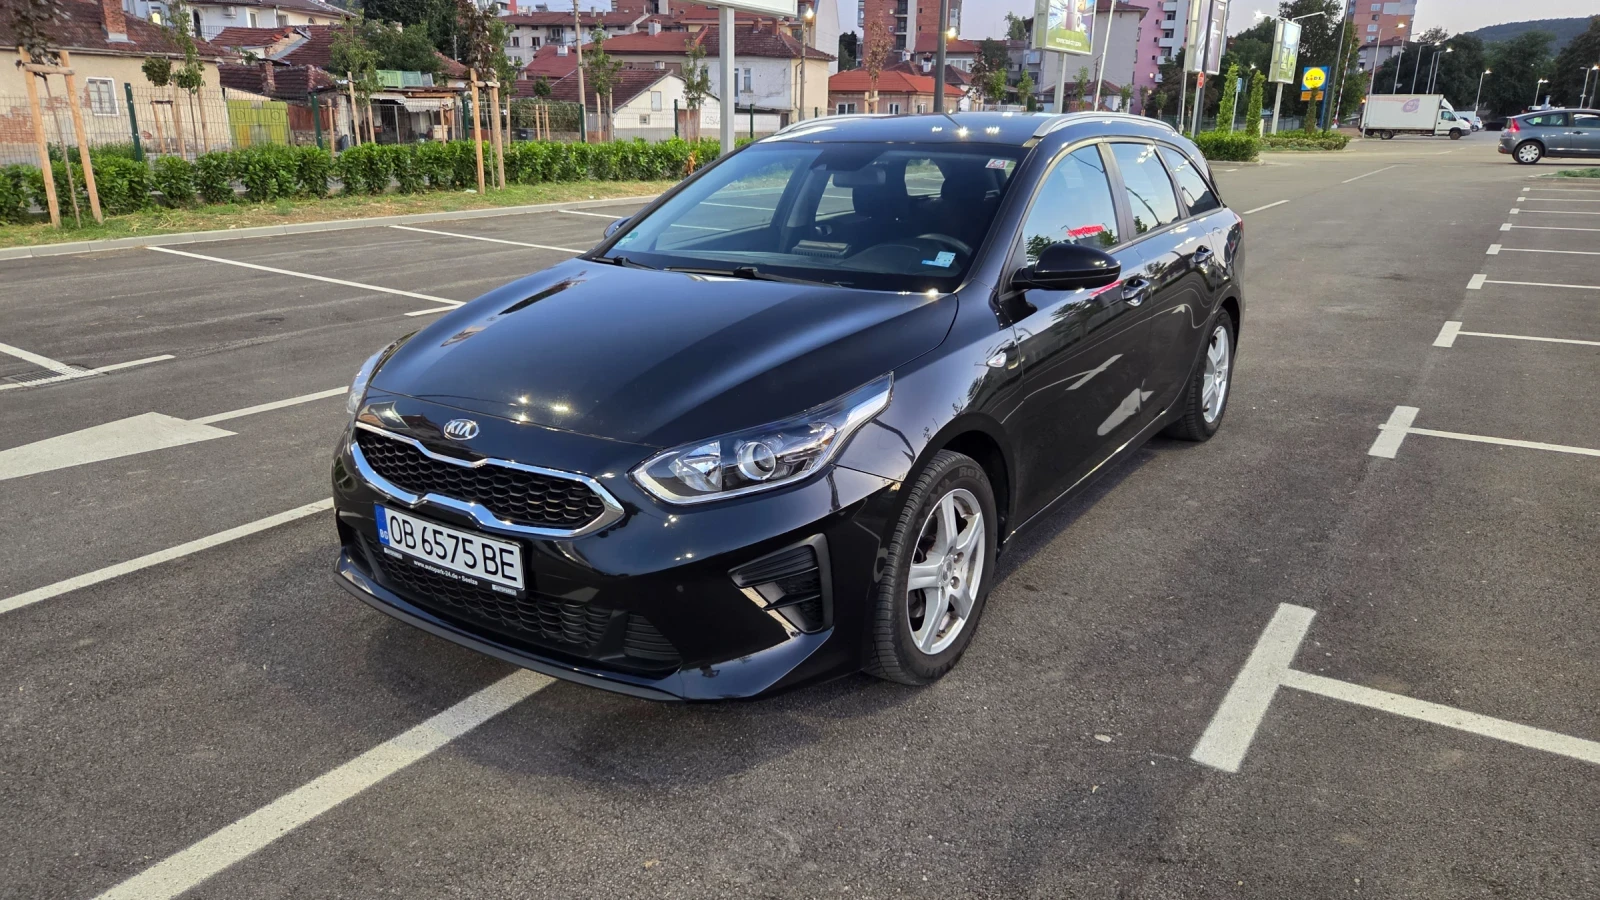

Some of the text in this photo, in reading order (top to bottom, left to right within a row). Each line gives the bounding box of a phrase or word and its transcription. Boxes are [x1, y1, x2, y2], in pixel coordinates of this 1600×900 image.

[446, 420, 472, 437] KIA
[379, 528, 389, 540] BG
[389, 514, 518, 582] OB 6575 BE
